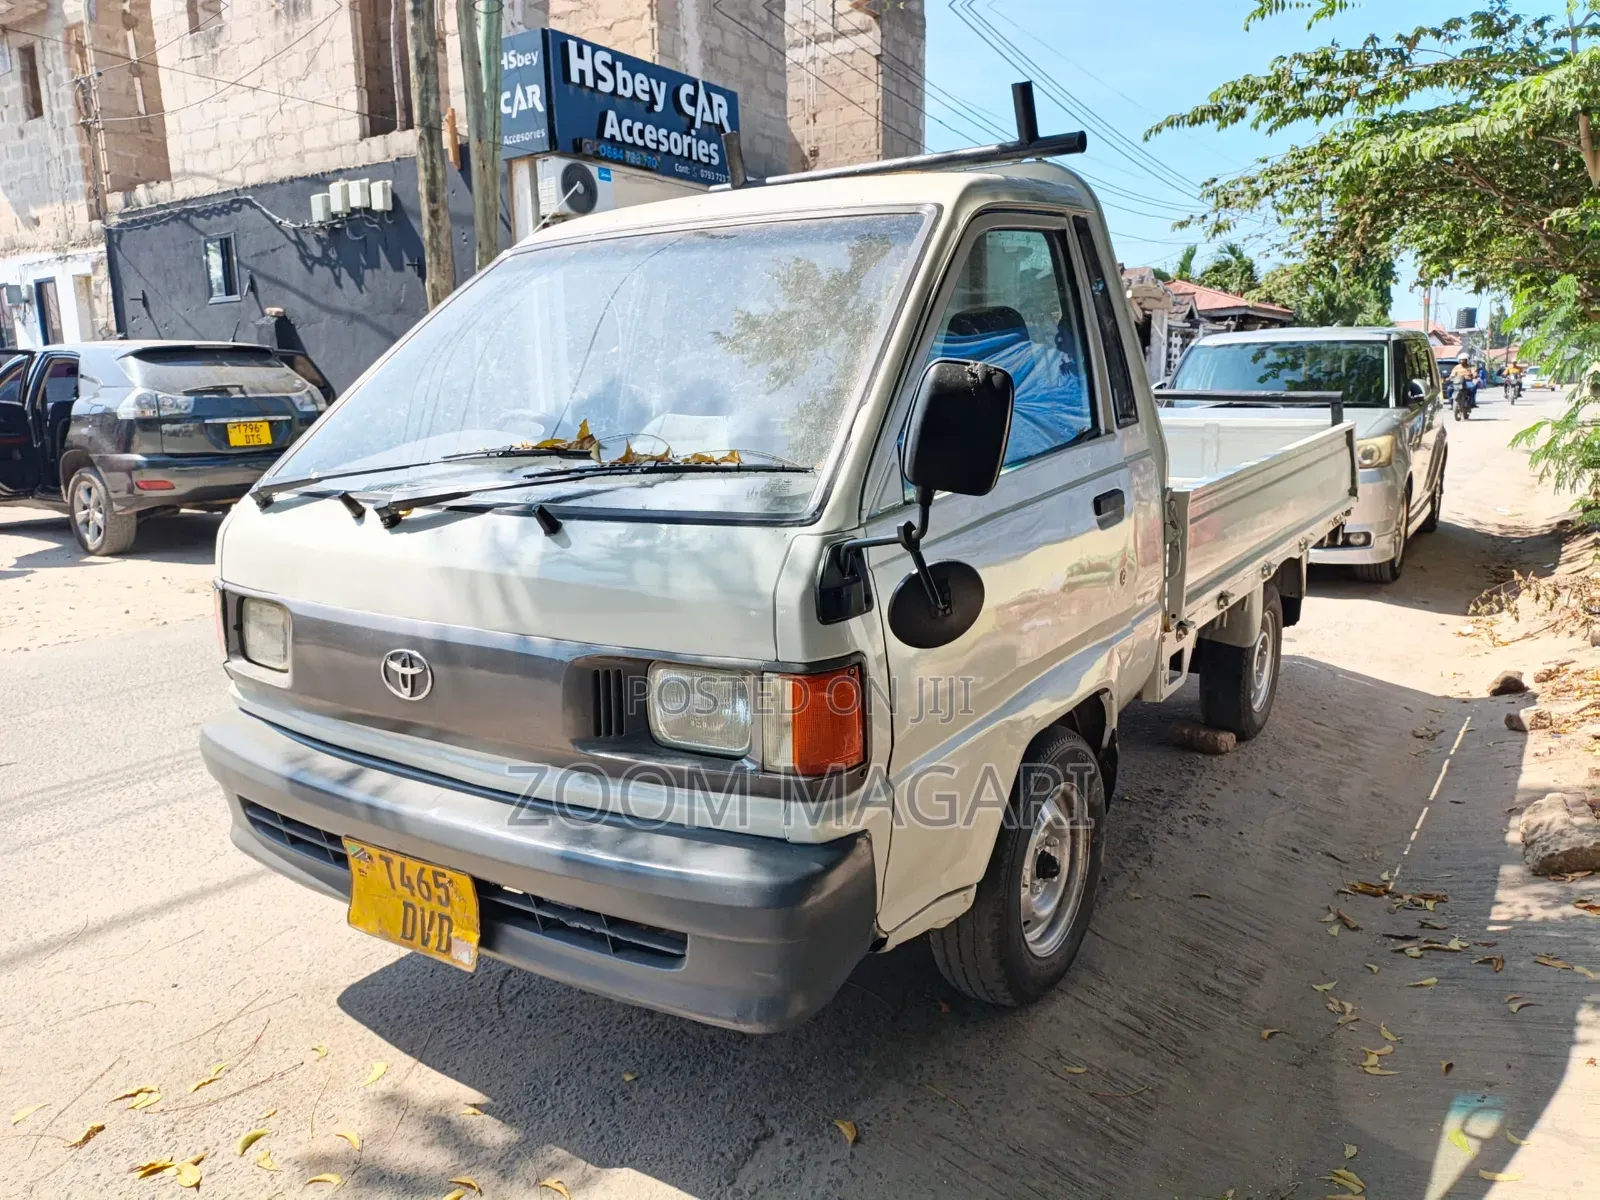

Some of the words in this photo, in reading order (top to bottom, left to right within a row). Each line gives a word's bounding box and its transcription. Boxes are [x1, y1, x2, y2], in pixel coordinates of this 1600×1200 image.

[500, 82, 545, 119] CAR
[567, 39, 667, 113] HSbey
[679, 80, 731, 134] CAR
[503, 128, 546, 145] Accesories
[603, 109, 720, 166] Accesories
[379, 854, 450, 908] T465
[401, 901, 453, 953] DVD
